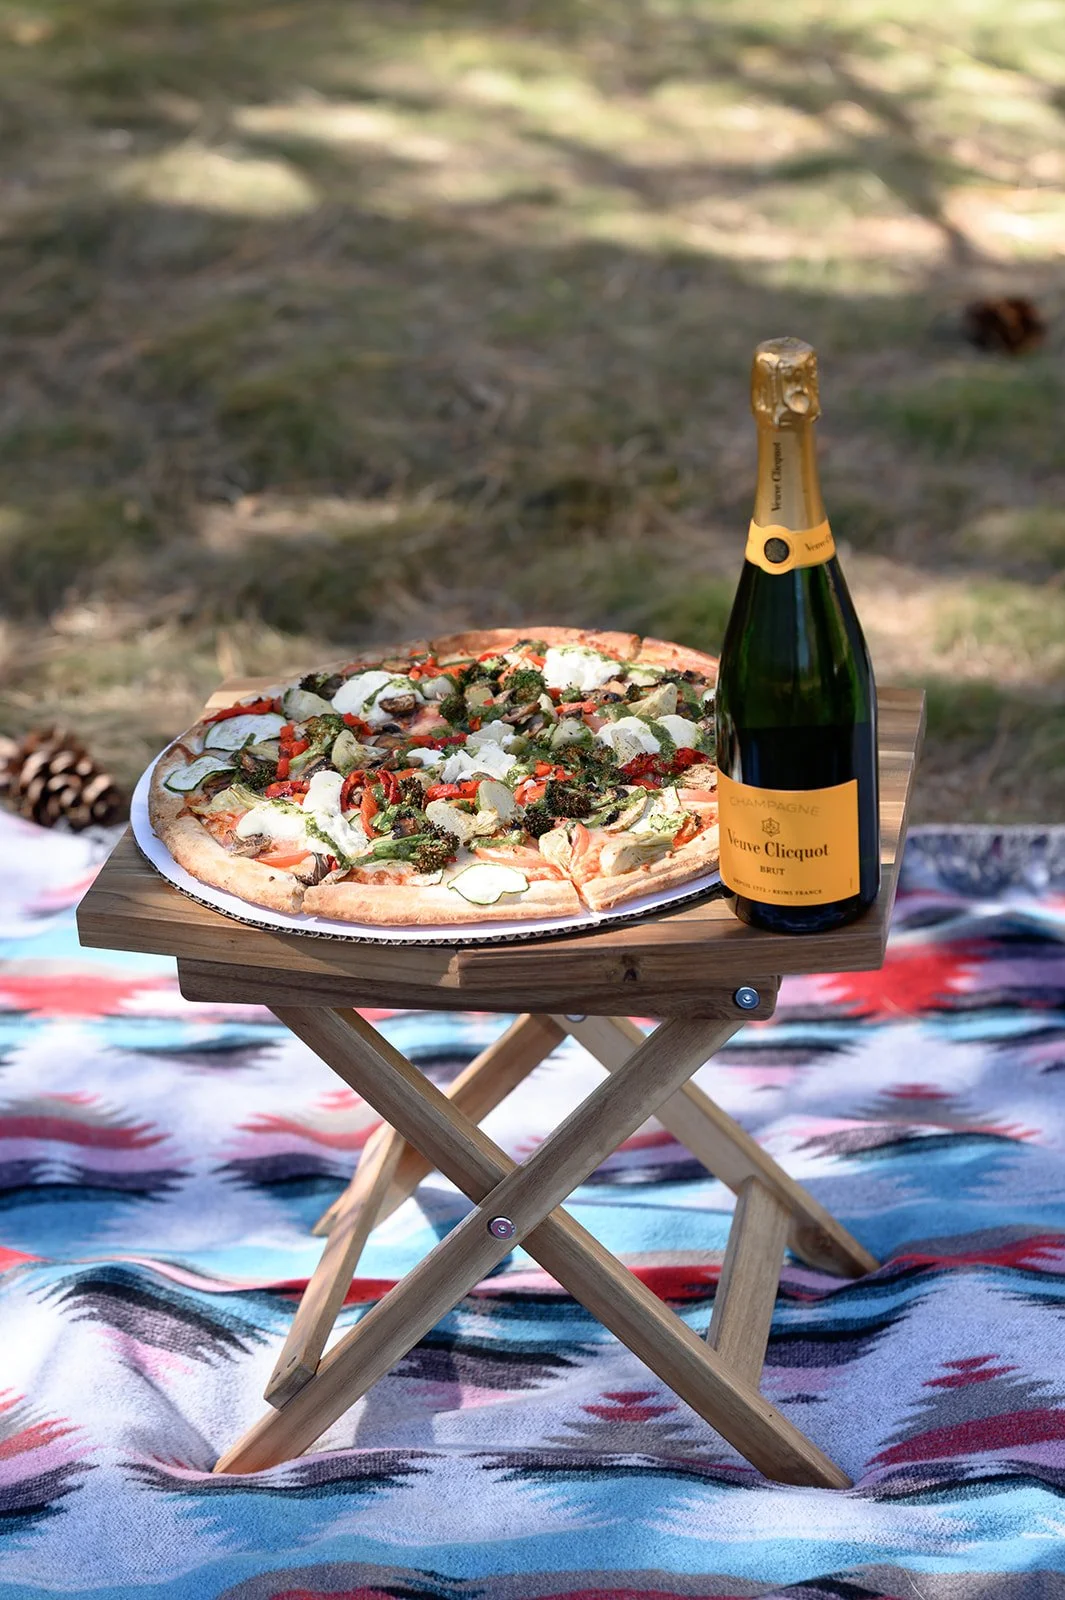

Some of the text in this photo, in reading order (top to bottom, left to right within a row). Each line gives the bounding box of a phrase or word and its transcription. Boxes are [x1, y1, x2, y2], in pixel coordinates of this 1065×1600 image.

[729, 796, 820, 817] CHAMPAGNE
[727, 828, 829, 862] Veuve Clicquot
[760, 865, 785, 876] BRUT
[795, 888, 822, 896] FRANCE
